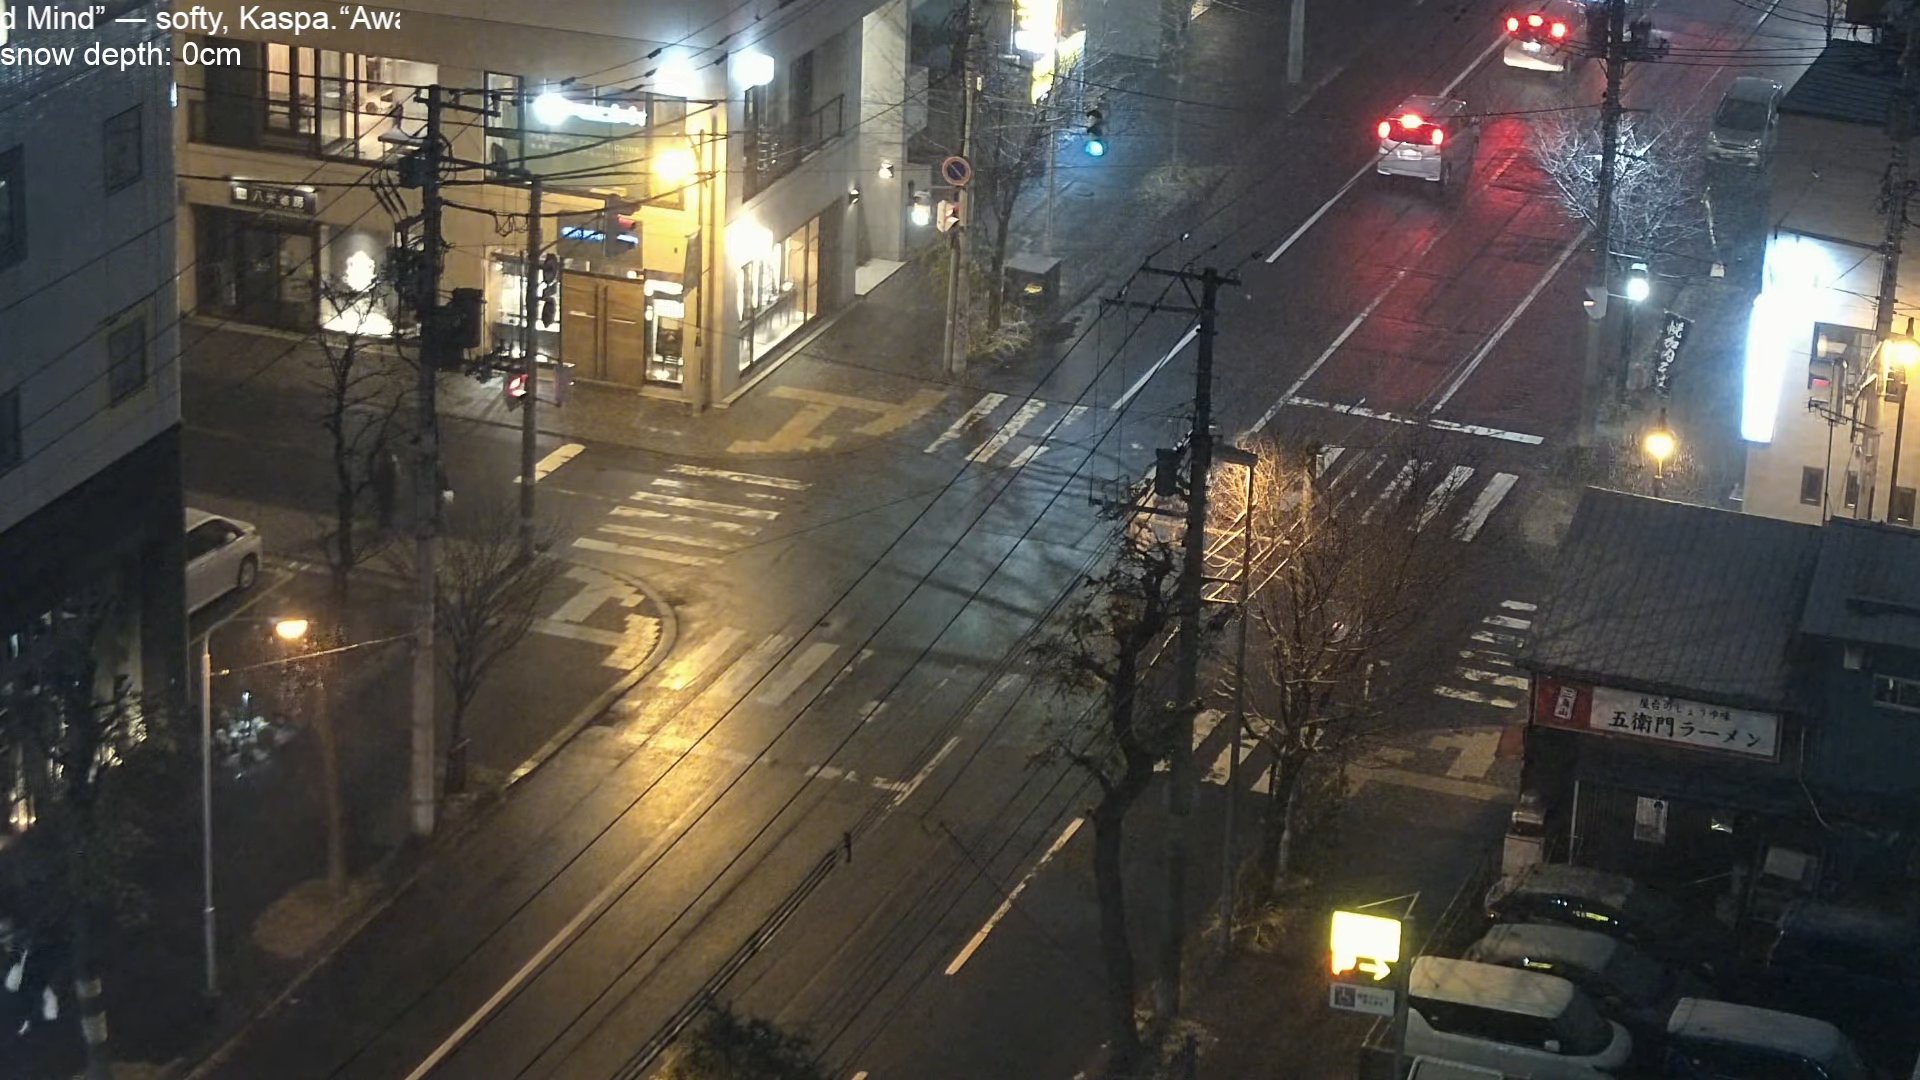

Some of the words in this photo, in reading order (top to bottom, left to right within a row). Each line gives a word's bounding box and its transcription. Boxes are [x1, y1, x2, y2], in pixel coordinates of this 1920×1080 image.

[1608, 710, 1762, 749] 五衛門ラーメン
